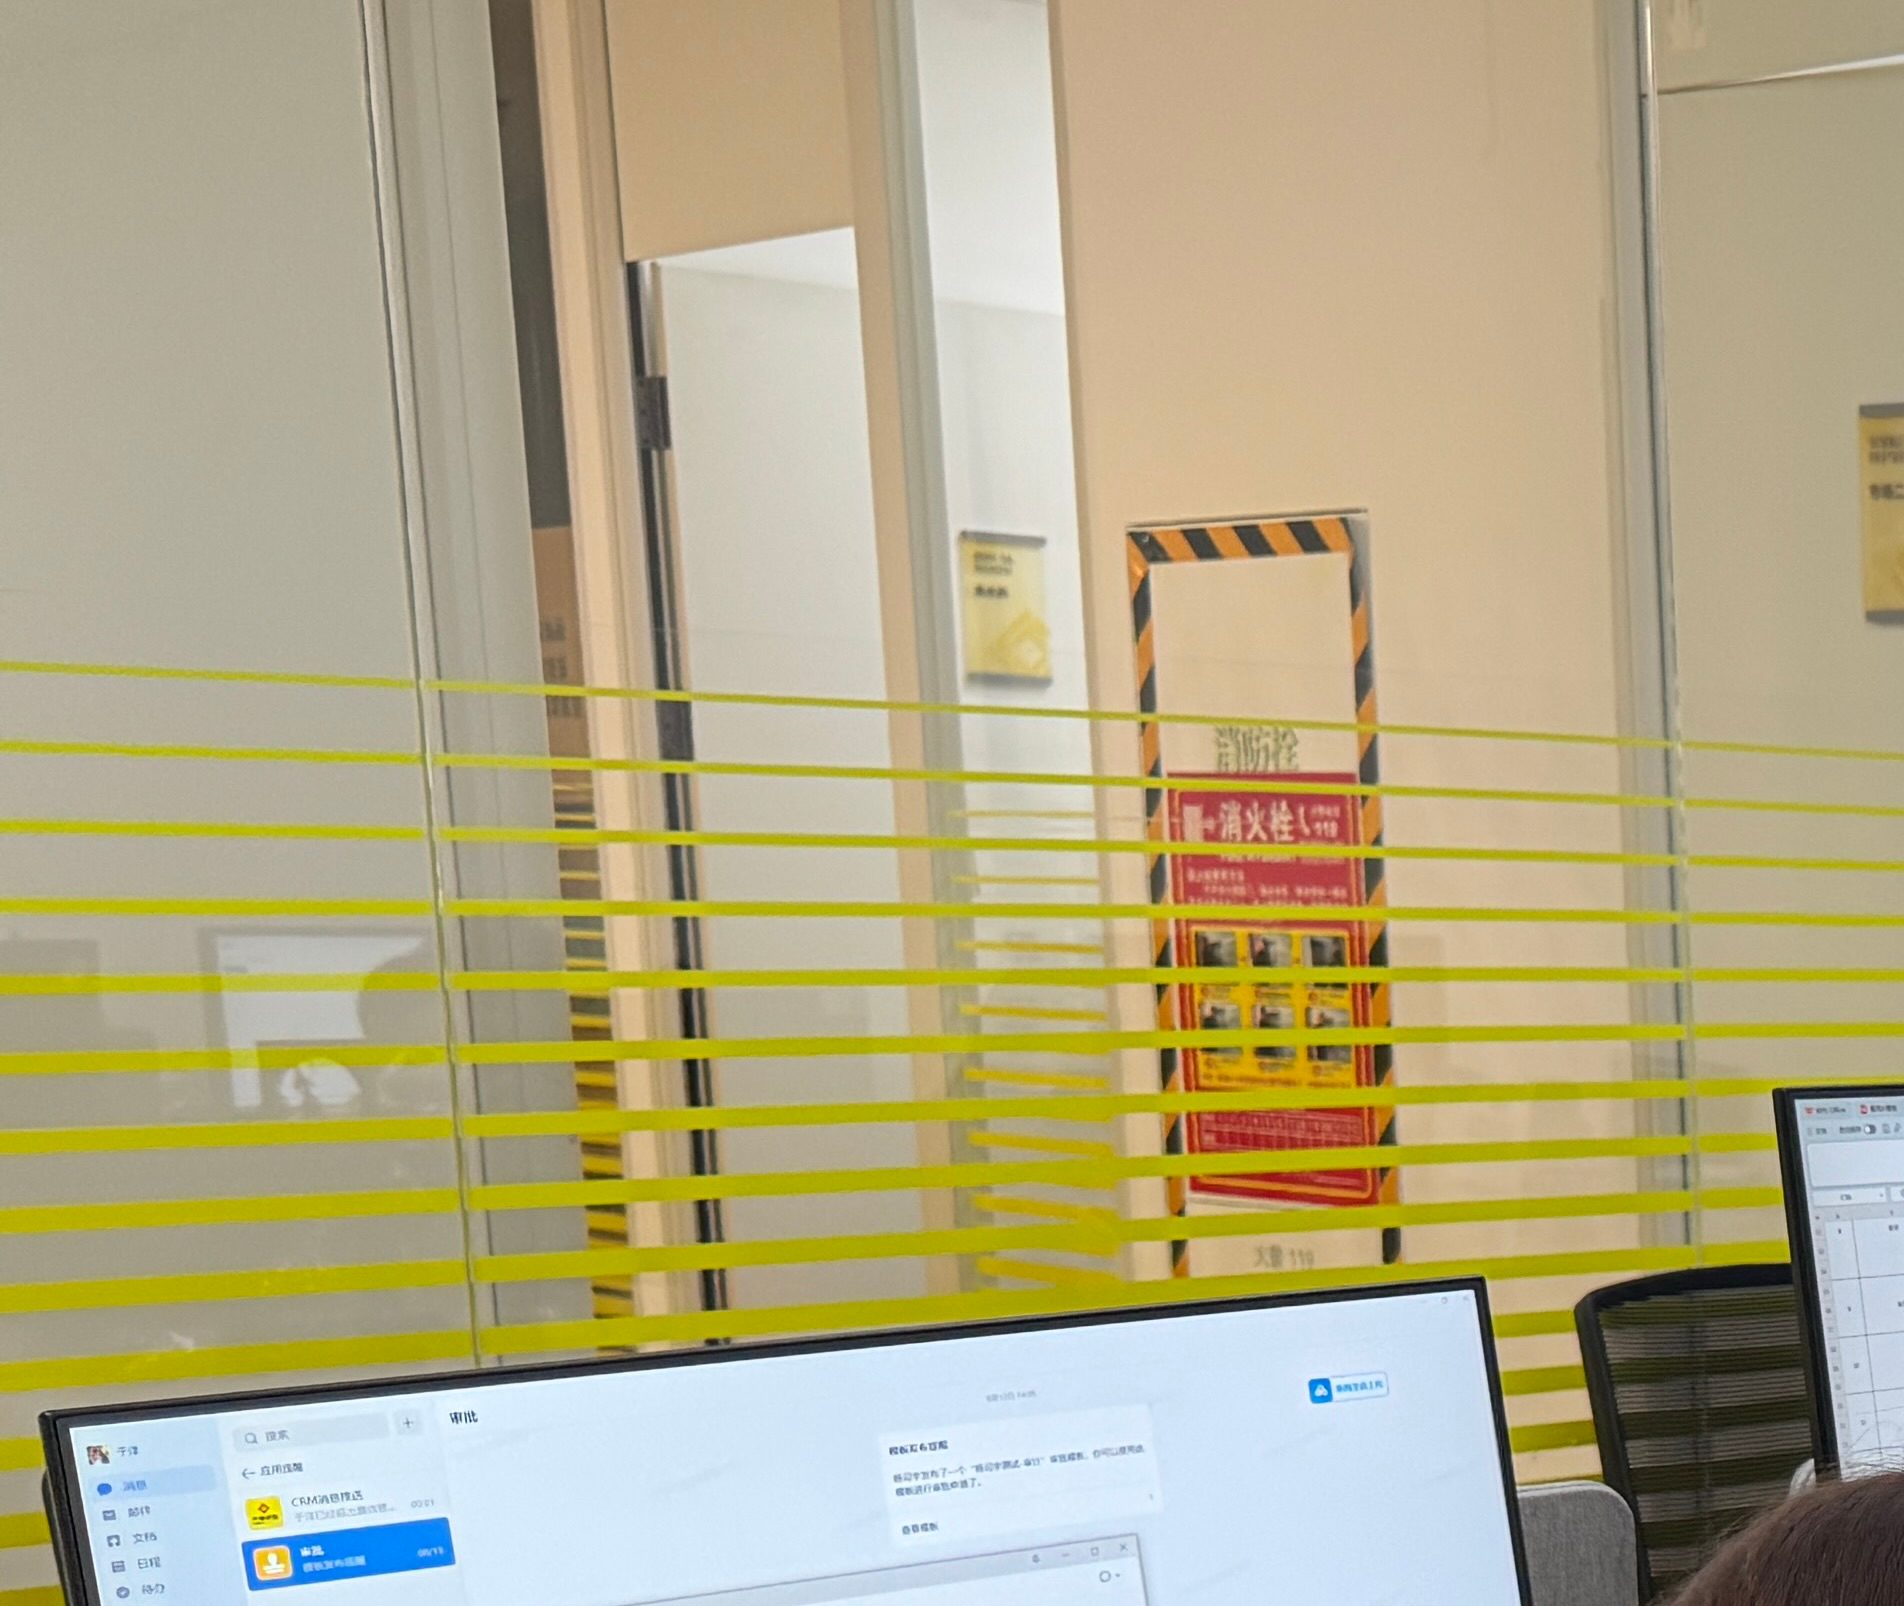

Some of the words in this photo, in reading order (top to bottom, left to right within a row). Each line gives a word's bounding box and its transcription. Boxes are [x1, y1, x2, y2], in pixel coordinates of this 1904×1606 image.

[1219, 799, 1294, 842] 消火栓
[132, 1532, 157, 1544] 文档
[137, 1556, 161, 1569] 日程
[142, 1583, 165, 1595] 待办
